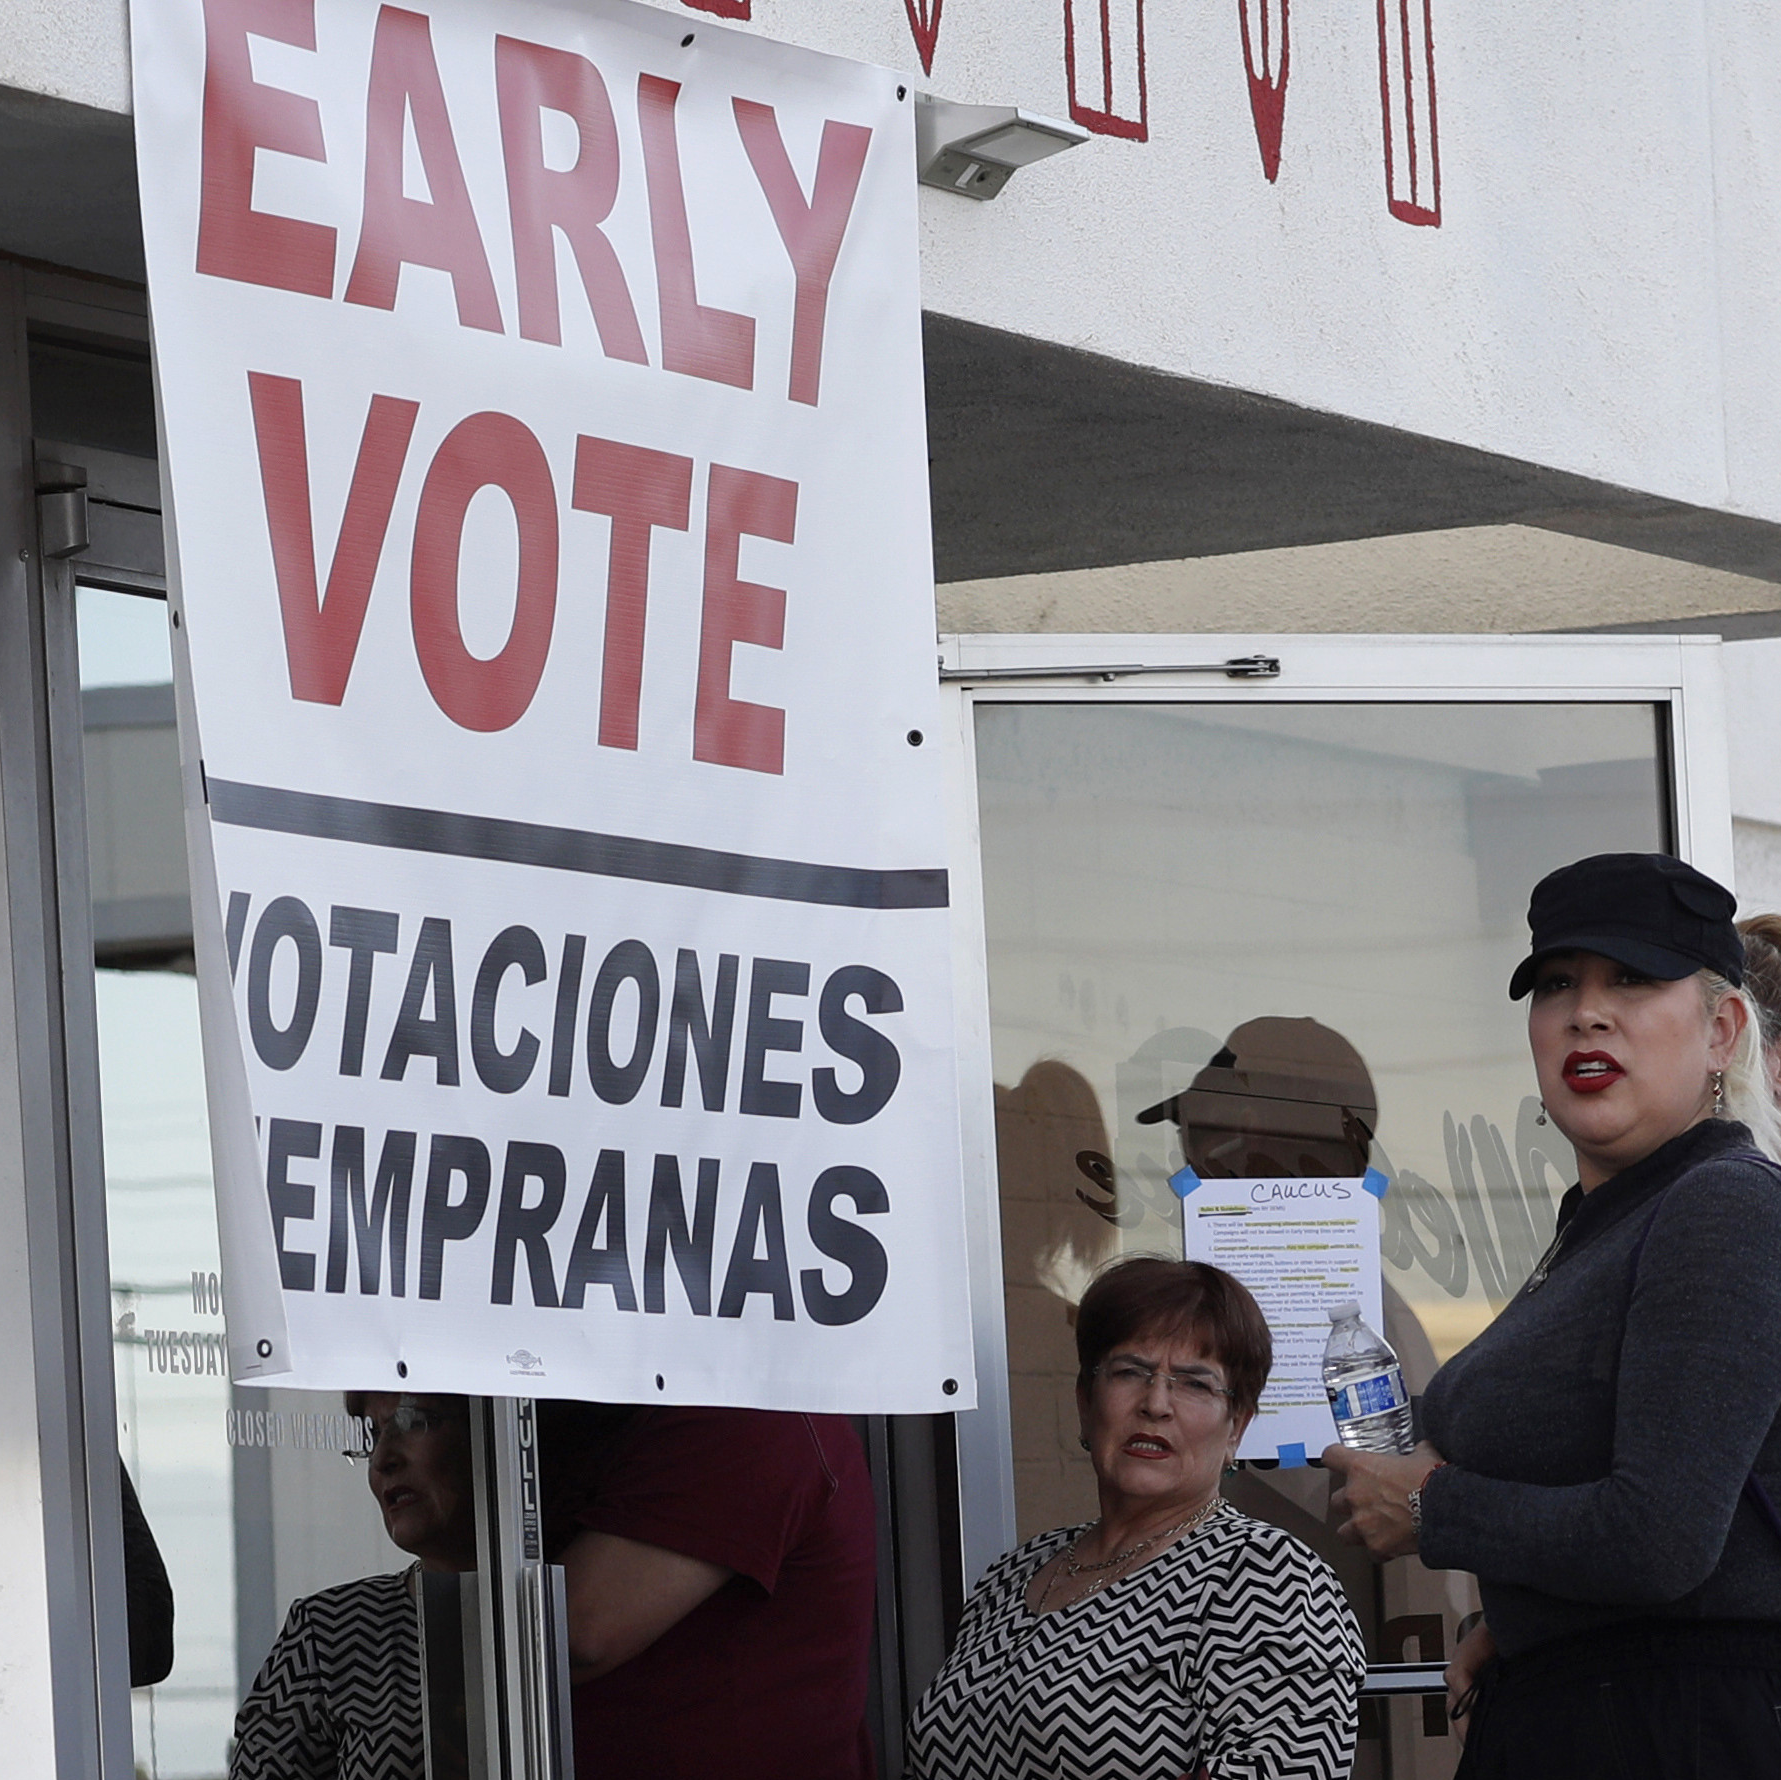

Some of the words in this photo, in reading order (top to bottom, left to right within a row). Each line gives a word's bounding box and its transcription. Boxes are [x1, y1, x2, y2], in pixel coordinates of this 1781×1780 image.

[195, 0, 873, 408] EARLY
[246, 370, 800, 776] VOTE
[256, 1114, 891, 1327] EMPRANAS
[1250, 1182, 1352, 1203] CAUCUS
[225, 1408, 285, 1449] CLOSED
[290, 1411, 375, 1454] WEEKENDS
[518, 1398, 536, 1511] PULL
